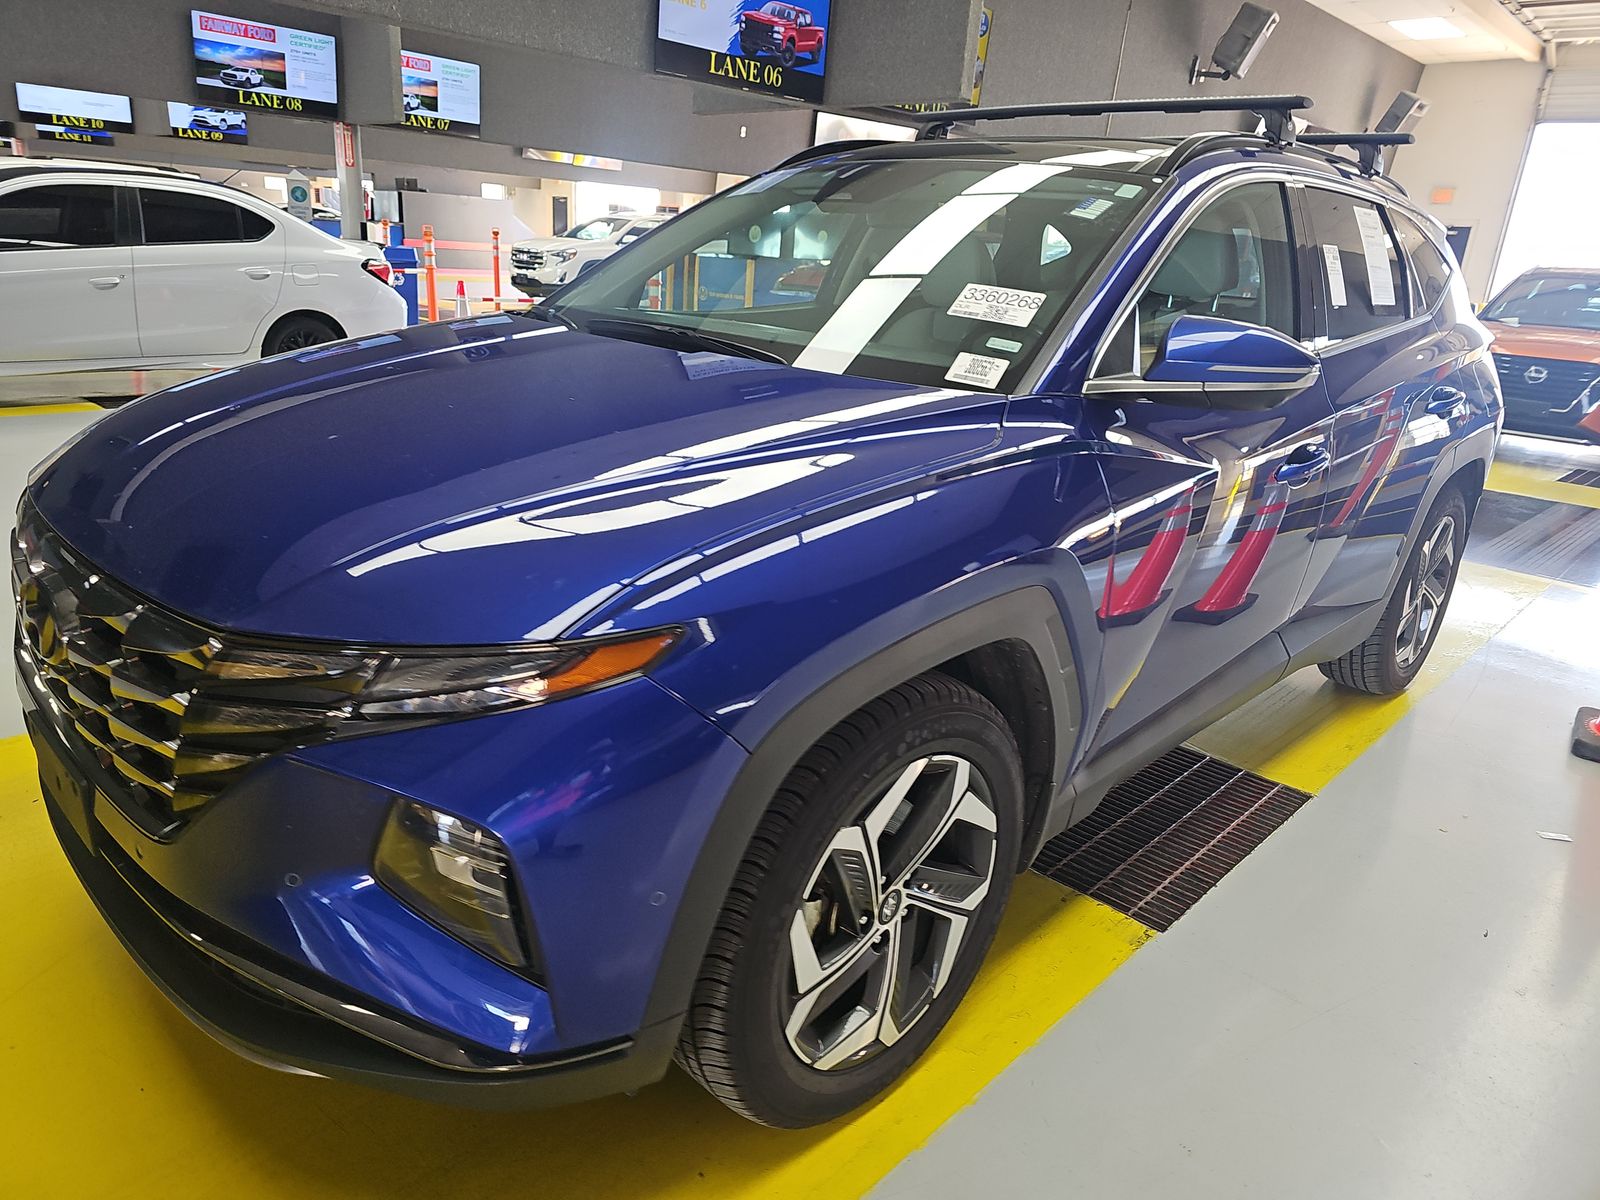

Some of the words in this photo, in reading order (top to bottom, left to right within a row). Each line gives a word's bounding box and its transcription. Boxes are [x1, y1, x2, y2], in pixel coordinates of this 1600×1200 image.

[200, 16, 245, 36] FAIRWAY
[247, 26, 275, 42] FORD
[709, 51, 761, 84] LANE
[764, 64, 783, 88] 06
[238, 90, 283, 110] LANE
[286, 97, 303, 111] 08
[52, 114, 89, 128] LANE
[91, 118, 105, 129] 10
[437, 118, 451, 131] 07
[54, 132, 82, 142] LANE
[82, 135, 92, 143] 11
[178, 128, 211, 140] LANE
[211, 131, 224, 141] 09
[963, 287, 1042, 310] 3360268
